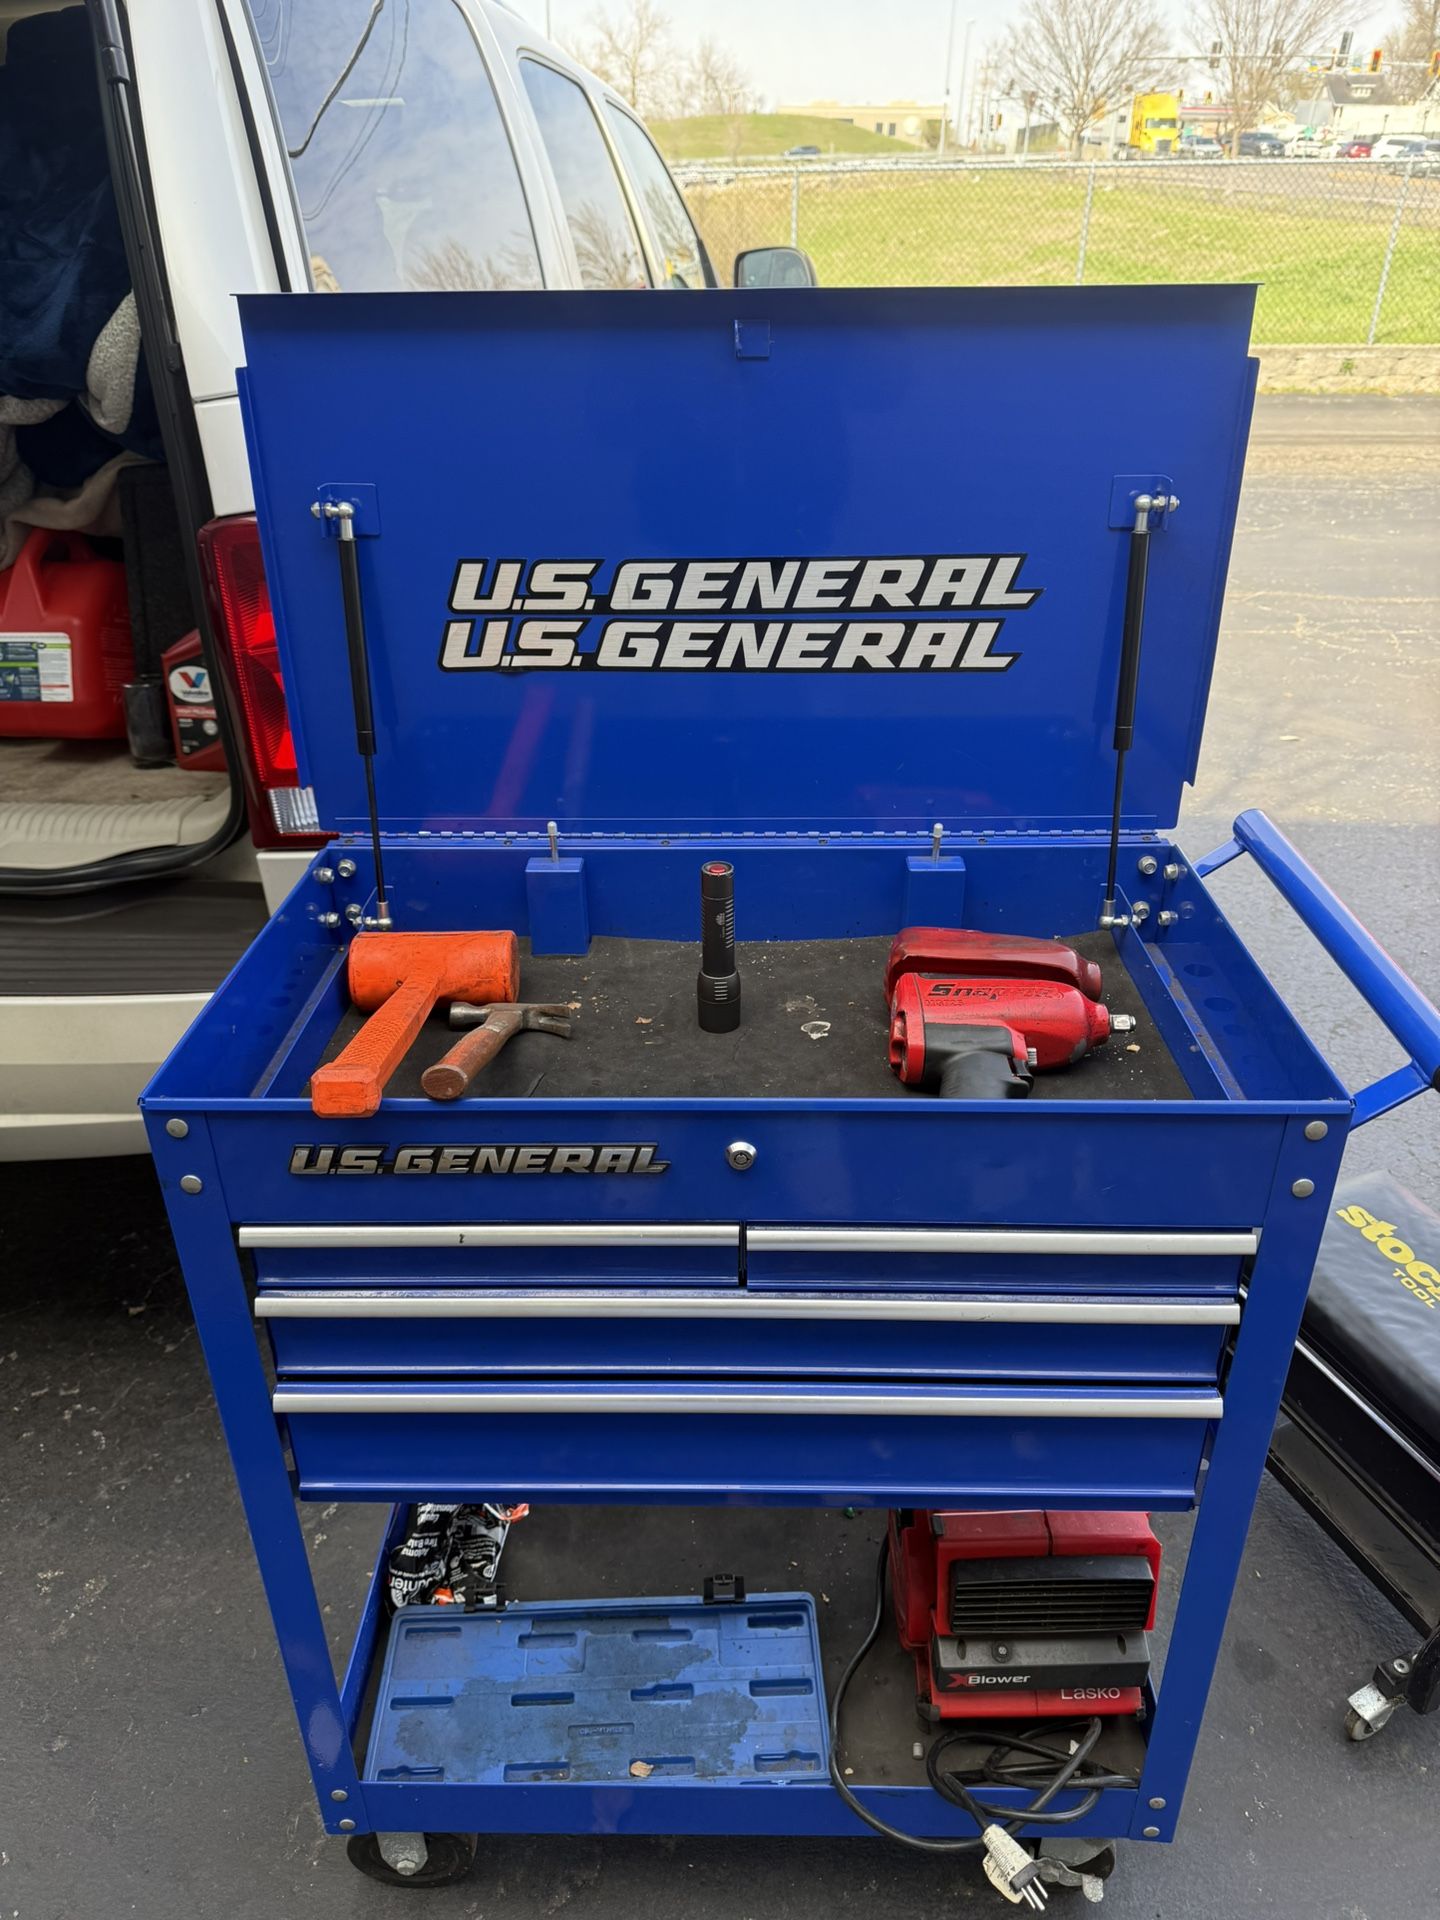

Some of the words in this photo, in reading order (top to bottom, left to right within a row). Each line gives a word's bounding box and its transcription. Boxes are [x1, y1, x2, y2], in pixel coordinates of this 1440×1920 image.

[451, 558, 597, 611] U.S.
[608, 556, 1037, 610] GENERAL
[441, 620, 583, 668] U.S.
[596, 620, 1015, 669] GENERAL
[291, 1145, 384, 1174] U.S.
[394, 1144, 670, 1174] GENERAL
[1392, 1268, 1435, 1309] TOOL
[948, 1673, 1031, 1688] XBlower
[1061, 1687, 1121, 1700] Lasko
